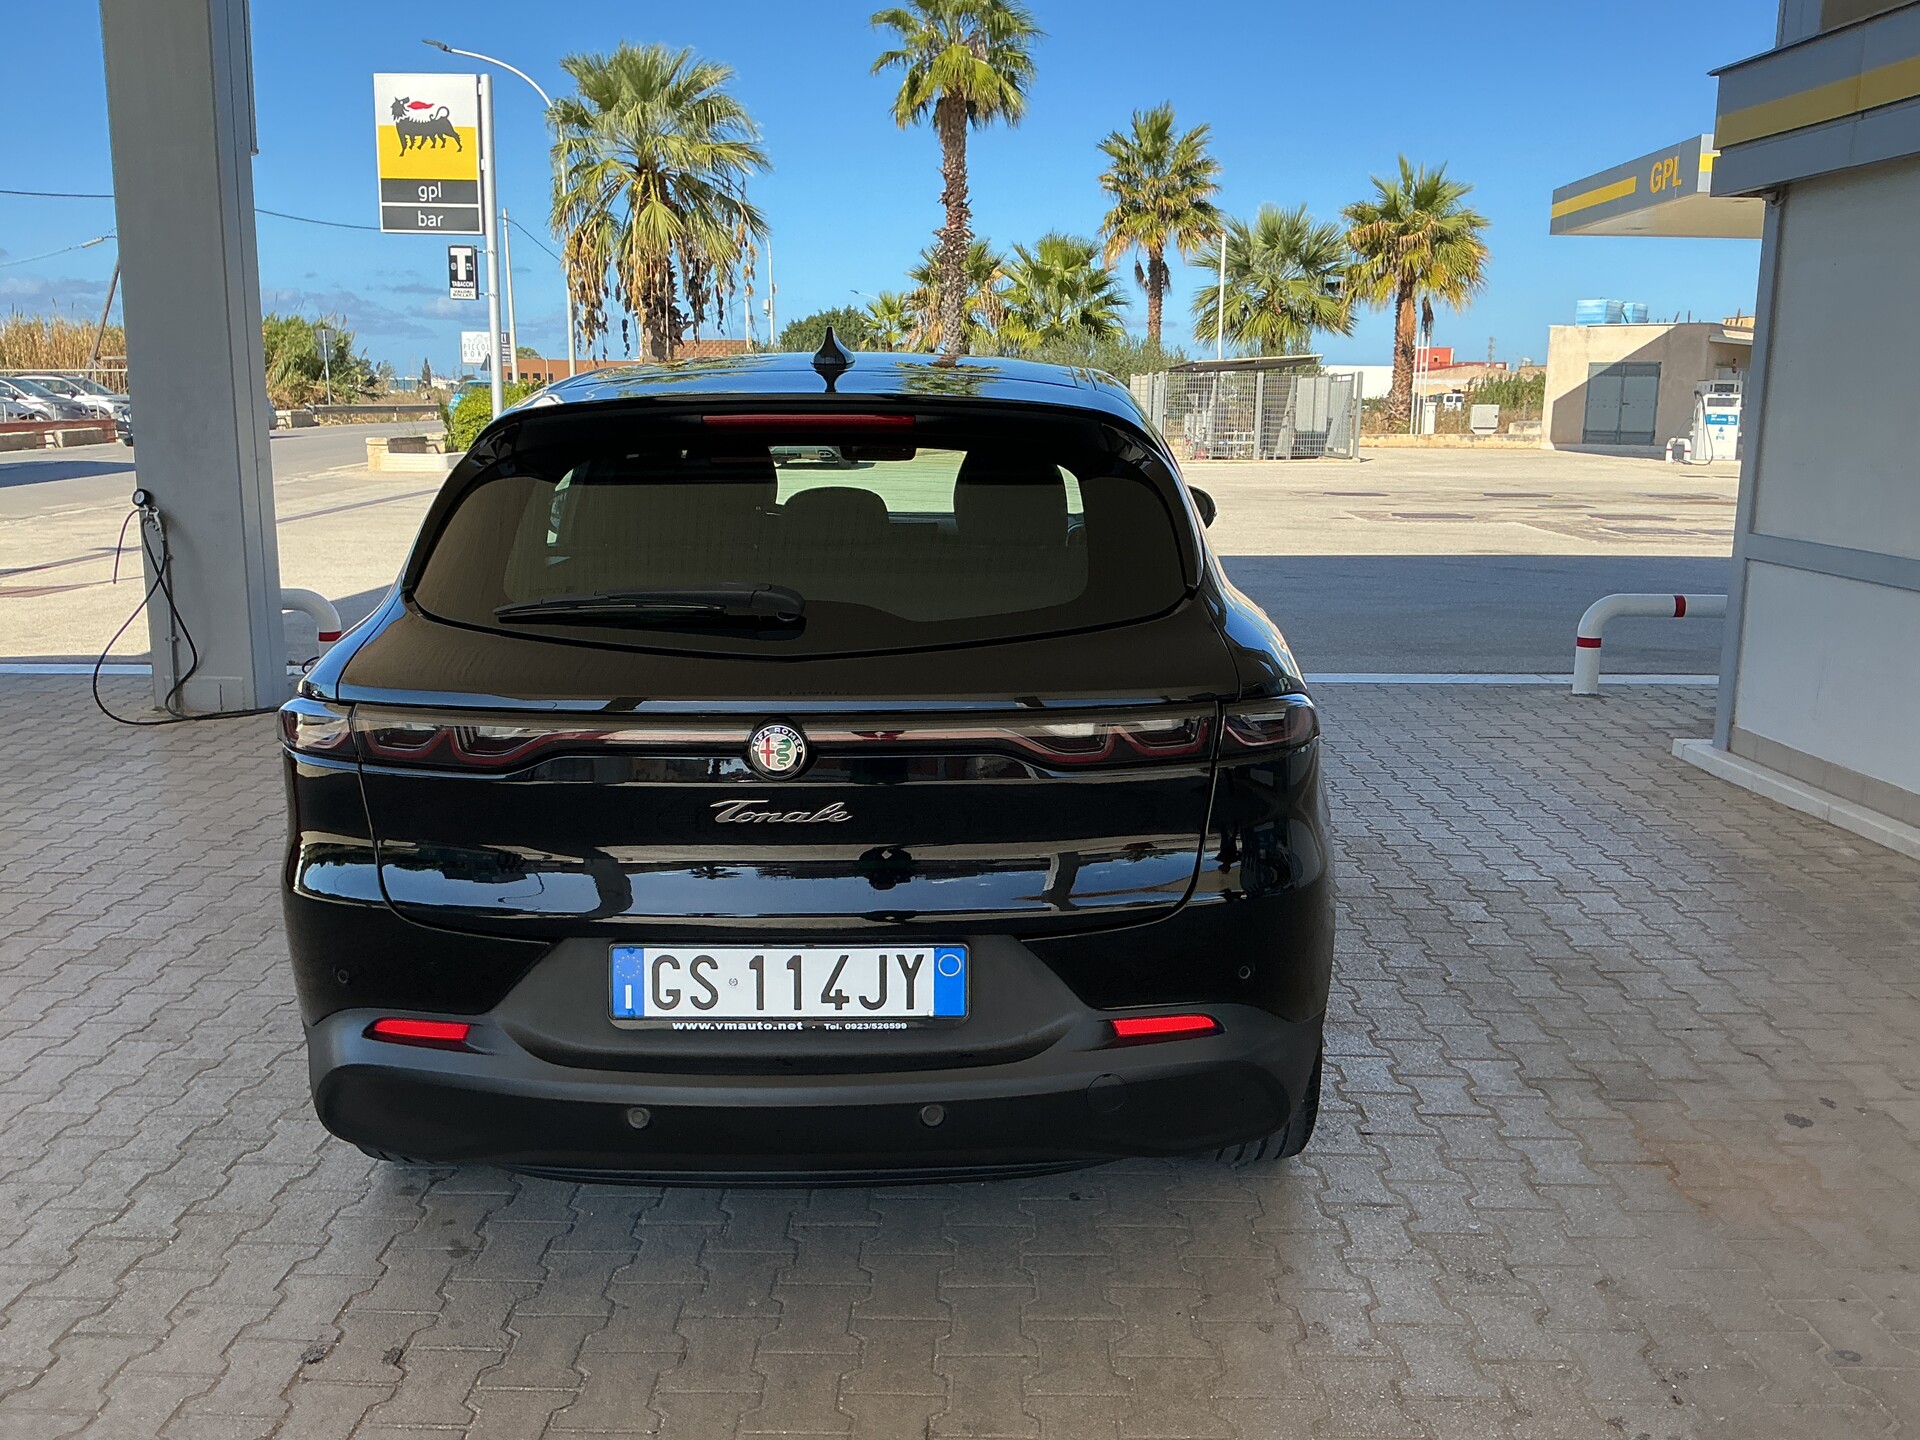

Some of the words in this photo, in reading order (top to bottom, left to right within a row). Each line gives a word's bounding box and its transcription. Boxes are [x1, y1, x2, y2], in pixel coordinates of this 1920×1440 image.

[1649, 154, 1682, 193] GPL
[418, 182, 442, 202] gpl
[418, 211, 444, 227] bar
[450, 248, 472, 281] T
[463, 343, 490, 351] PICCOL
[753, 730, 770, 753] ALFA
[774, 727, 804, 753] ROMEO
[710, 799, 853, 824] Tonale
[651, 954, 719, 1011] GS
[749, 954, 925, 1011] 114JY
[672, 1021, 804, 1031] www.vmauto.net
[824, 1022, 843, 1030] Tel.
